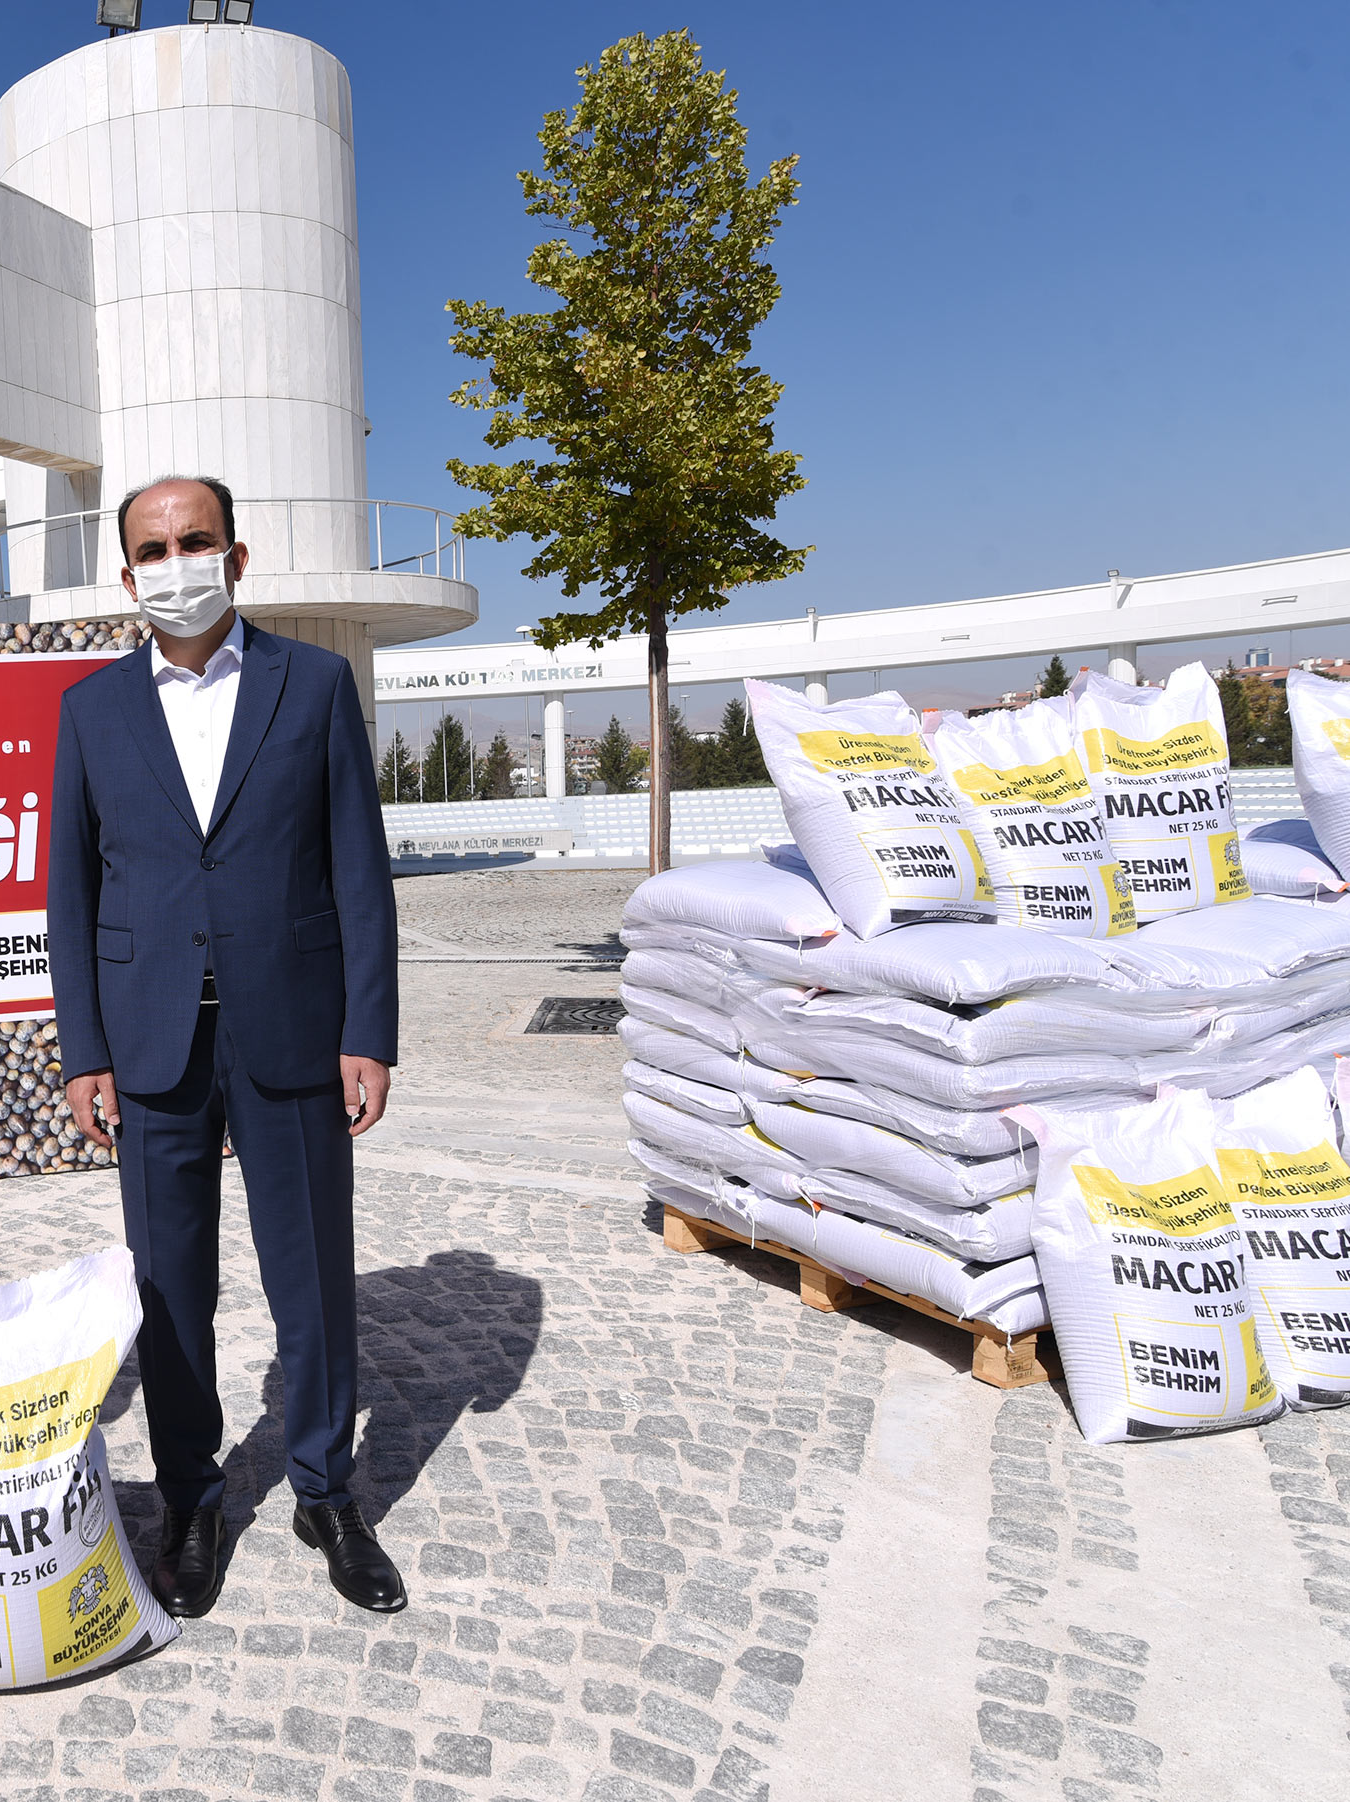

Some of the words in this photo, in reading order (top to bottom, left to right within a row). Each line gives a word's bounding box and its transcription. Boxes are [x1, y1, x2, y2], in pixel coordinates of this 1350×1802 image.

[374, 674, 440, 690] EVLANA
[1117, 740, 1164, 759] Üretmek
[1163, 734, 1203, 750] Sizden
[980, 786, 1022, 801] Deste
[1104, 788, 1214, 819] MACAR
[915, 813, 936, 823] NET
[990, 805, 1043, 818] STANDART
[993, 821, 1096, 849] MACAR
[1169, 822, 1190, 834] NET
[1192, 821, 1203, 831] 25
[1206, 819, 1219, 829] KG
[419, 841, 460, 852] MEVLANA
[463, 837, 499, 850] KÜLTÜR
[502, 833, 544, 849] MERKEZİ
[1062, 851, 1081, 862] NET
[1082, 850, 1092, 861] 25
[1093, 849, 1104, 860] KG
[1159, 1186, 1209, 1208] Sizden
[1106, 1202, 1150, 1218] Dest
[1242, 1208, 1310, 1219] STANDART
[1111, 1254, 1239, 1295] MACAR
[1194, 1304, 1218, 1319] NET
[1221, 1304, 1234, 1317] 25
[1233, 1300, 1246, 1315] KG
[10, 1390, 70, 1422] Sizden
[10, 1569, 32, 1586] 25
[36, 1557, 58, 1580] KG
[52, 1597, 130, 1665] BÜYÜKŞEHİR
[74, 1604, 113, 1639] KONYA
[72, 1625, 122, 1663] BELEDİYESİ
